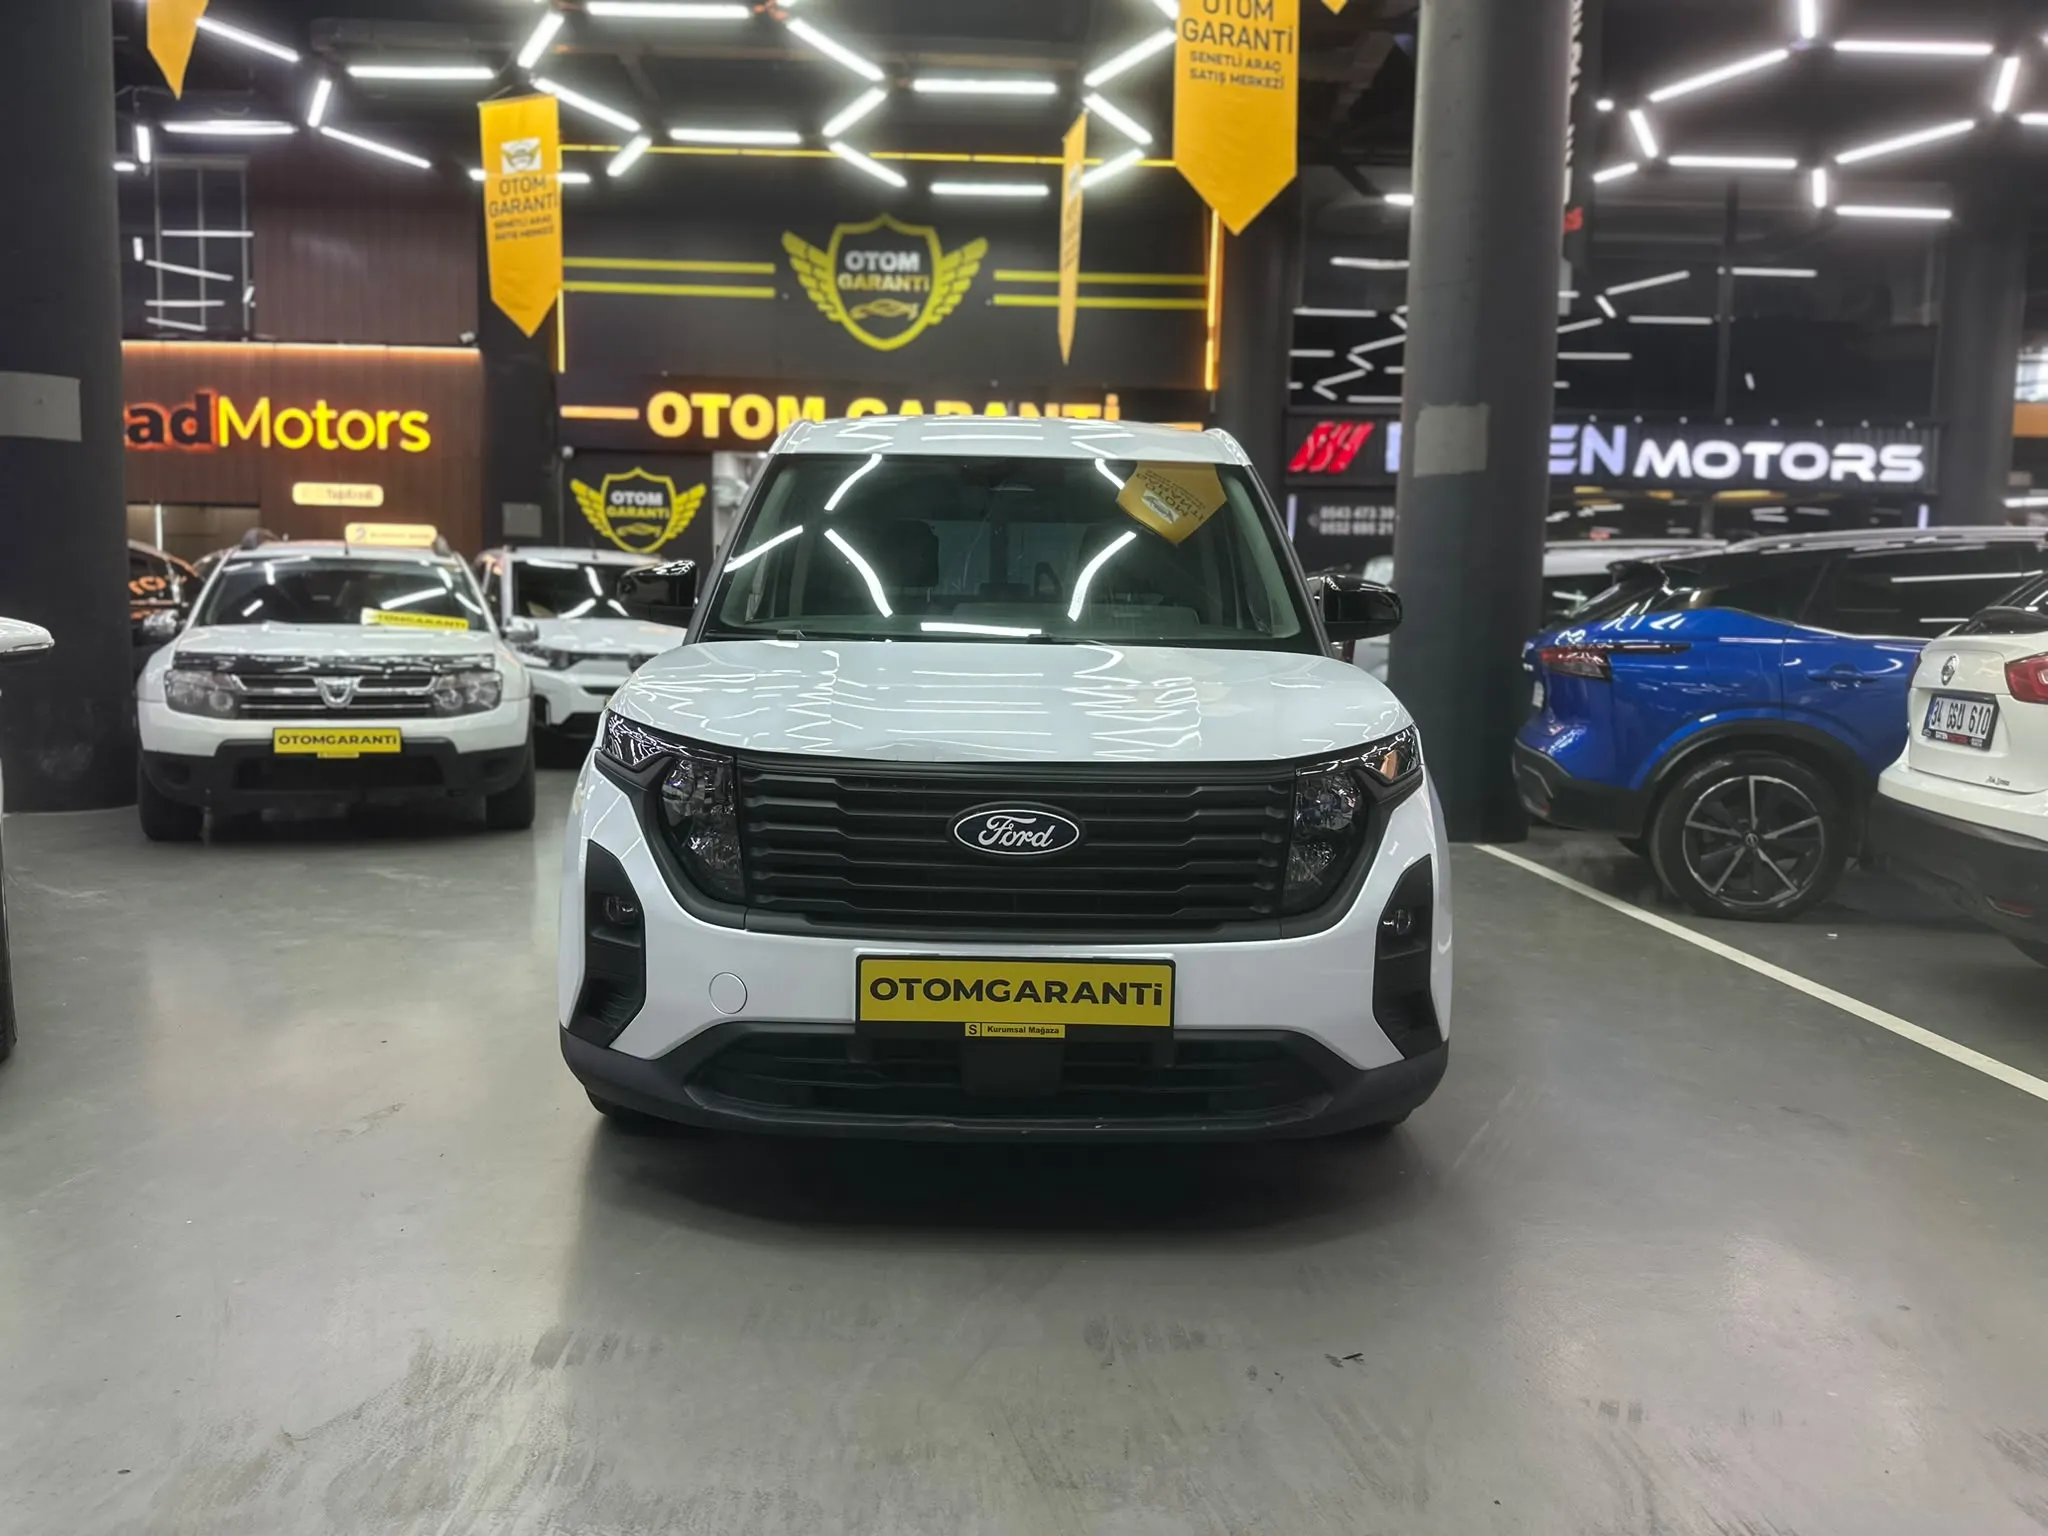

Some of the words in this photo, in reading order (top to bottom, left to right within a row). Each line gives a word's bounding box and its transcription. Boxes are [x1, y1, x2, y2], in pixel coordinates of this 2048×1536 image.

[1182, 18, 1293, 54] GARANTİ
[1190, 68, 1226, 85] SATIŞ
[1246, 58, 1282, 74] ARAÇ
[499, 176, 546, 196] OTOM
[844, 250, 920, 272] OTOM
[646, 390, 826, 441] OTOM
[1632, 439, 1925, 483] MOTORS
[610, 490, 664, 506] OTOM
[1931, 700, 1944, 727] 34
[1968, 704, 1992, 736] 610
[977, 815, 1055, 848] Ford
[968, 1024, 978, 1036] S
[987, 1025, 1027, 1034] Kurumsal
[1028, 1026, 1060, 1036] Mağaza
